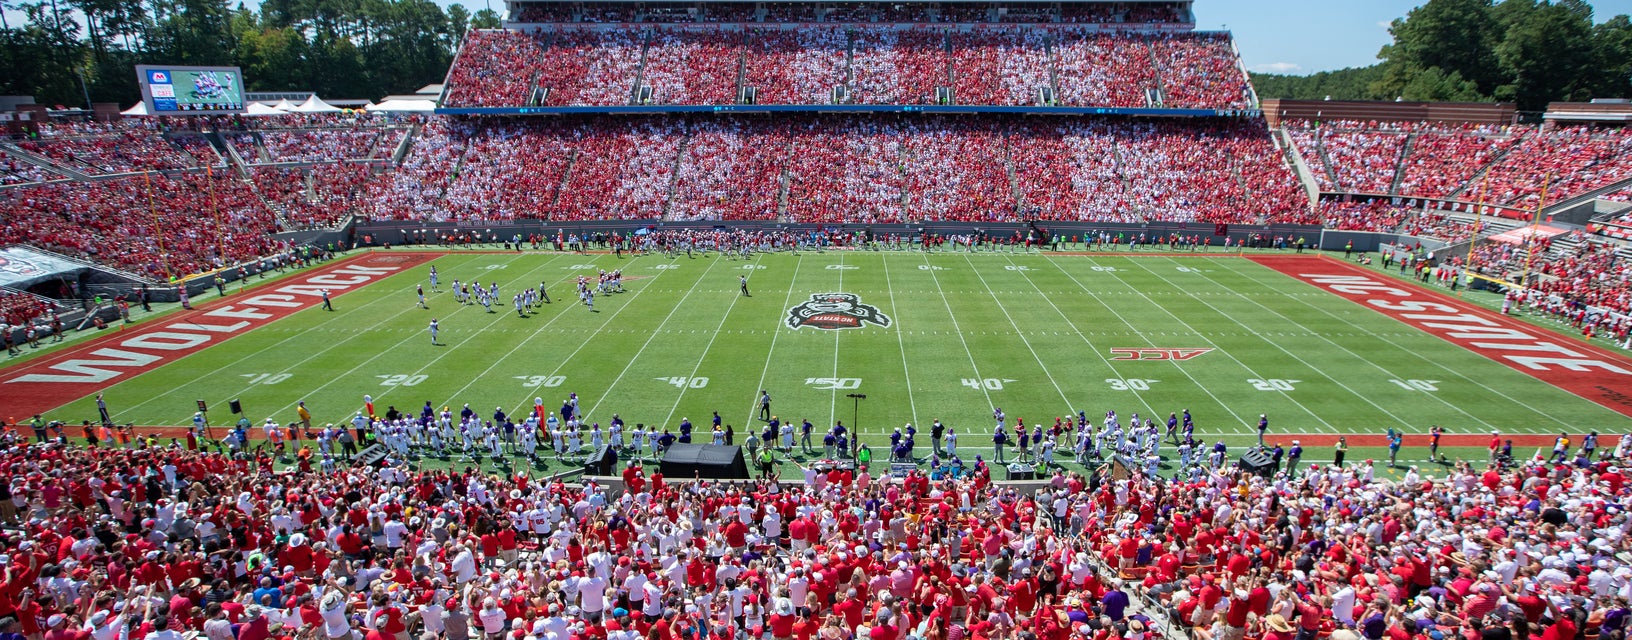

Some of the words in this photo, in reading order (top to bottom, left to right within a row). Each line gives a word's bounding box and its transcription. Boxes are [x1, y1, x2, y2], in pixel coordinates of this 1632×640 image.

[3, 264, 402, 384] WOLFPACK
[1299, 273, 1412, 296] NC
[1367, 299, 1632, 376] STATE
[1107, 347, 1217, 361] ACC
[247, 373, 294, 385] 10
[378, 374, 429, 387] 20
[522, 375, 567, 387] 30
[668, 376, 709, 389] 40
[960, 378, 1003, 391] 40
[1105, 378, 1150, 391] 30
[1246, 378, 1296, 391] 20
[1387, 379, 1439, 392] 10
[34, 615, 47, 631] 17
